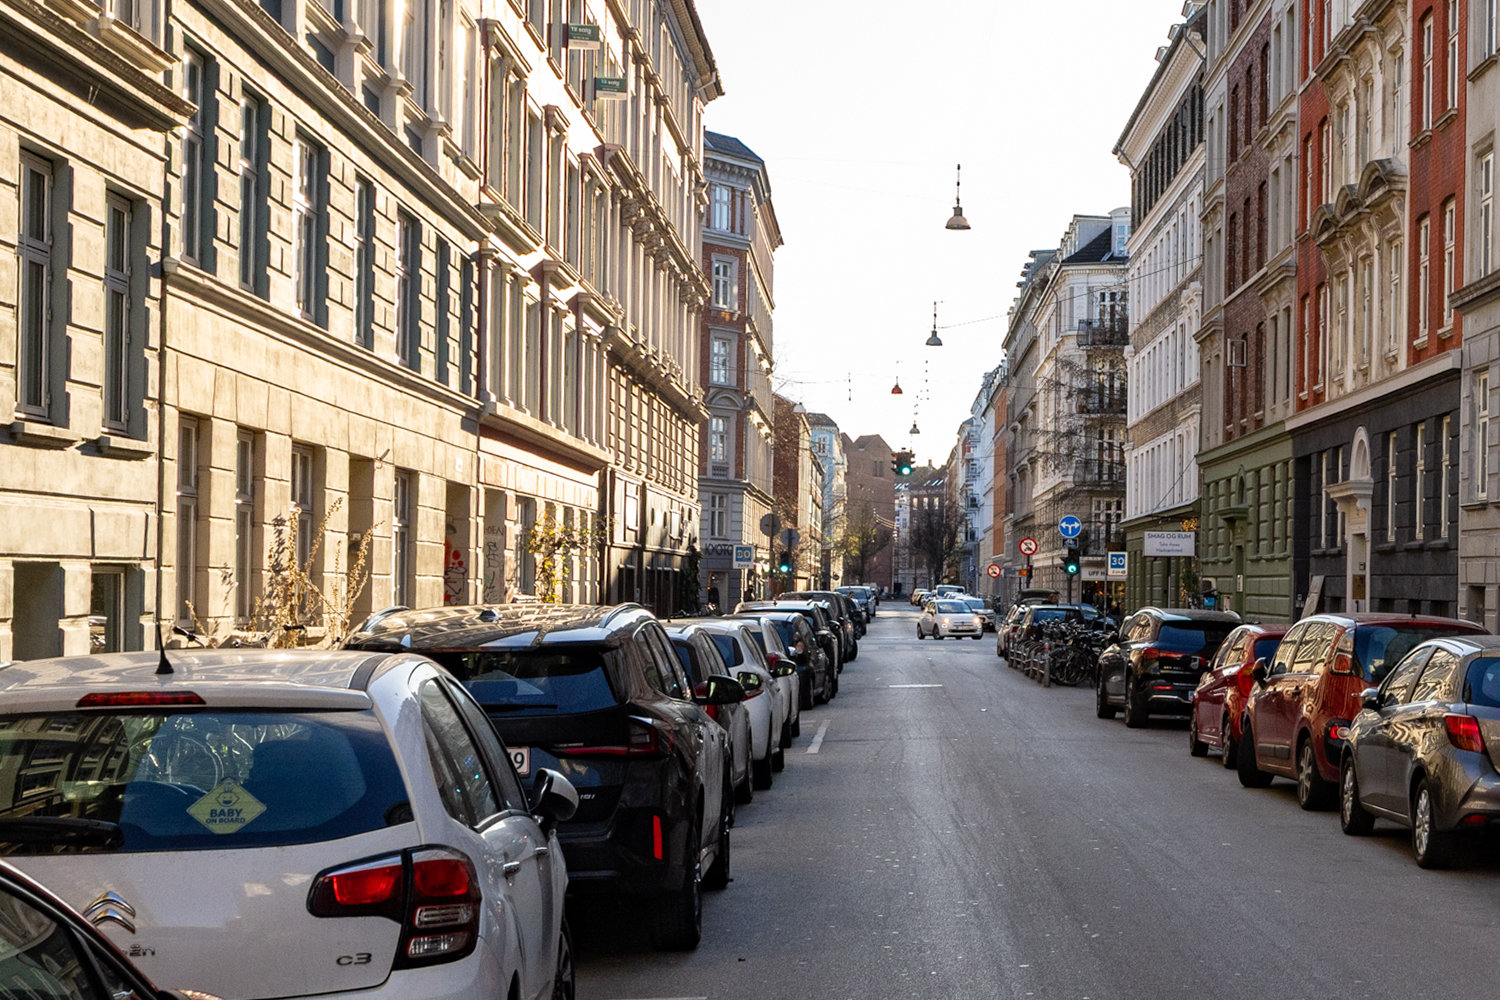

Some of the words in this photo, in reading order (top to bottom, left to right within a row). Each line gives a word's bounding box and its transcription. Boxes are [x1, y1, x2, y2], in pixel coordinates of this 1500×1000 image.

[737, 550, 751, 559] 30
[1111, 556, 1125, 566] 30
[209, 808, 243, 818] BABY
[336, 952, 372, 966] C3
